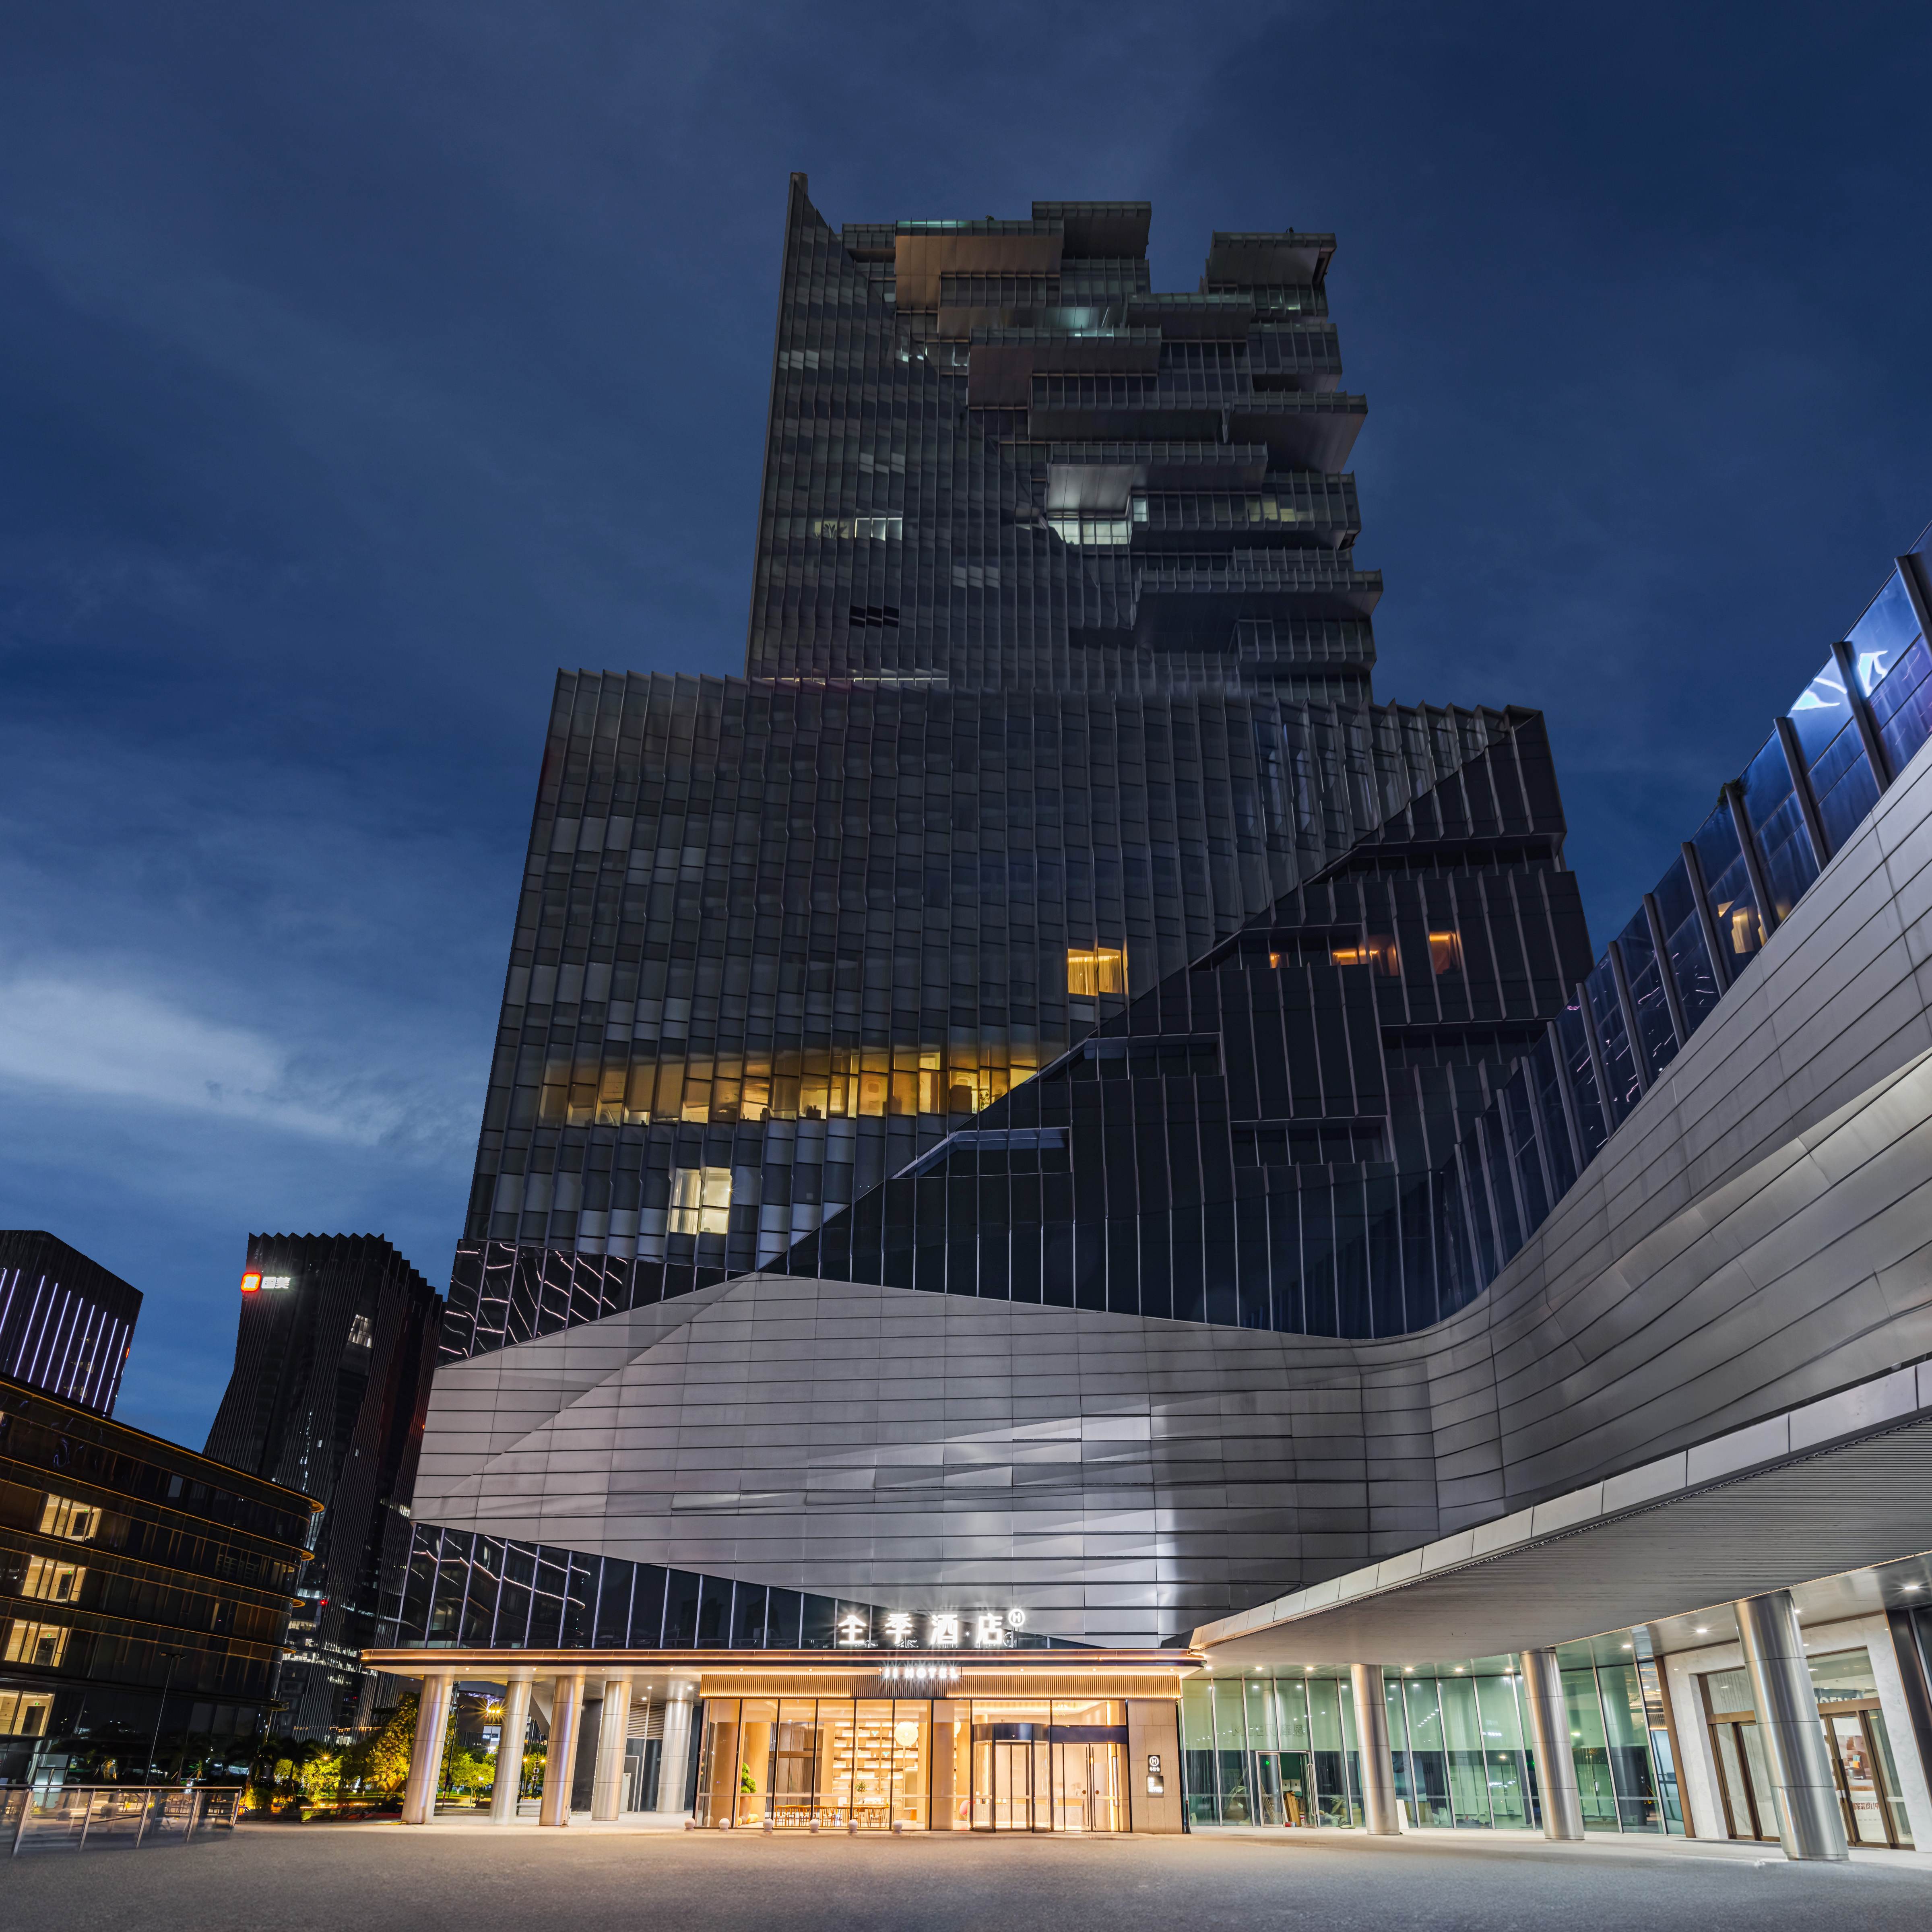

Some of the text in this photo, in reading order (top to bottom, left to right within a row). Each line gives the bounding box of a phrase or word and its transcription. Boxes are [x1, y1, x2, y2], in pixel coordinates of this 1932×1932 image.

[262, 1277, 291, 1289] 国美
[838, 1613, 1003, 1645] 全季酒店
[904, 1668, 958, 1678] HOTEL
